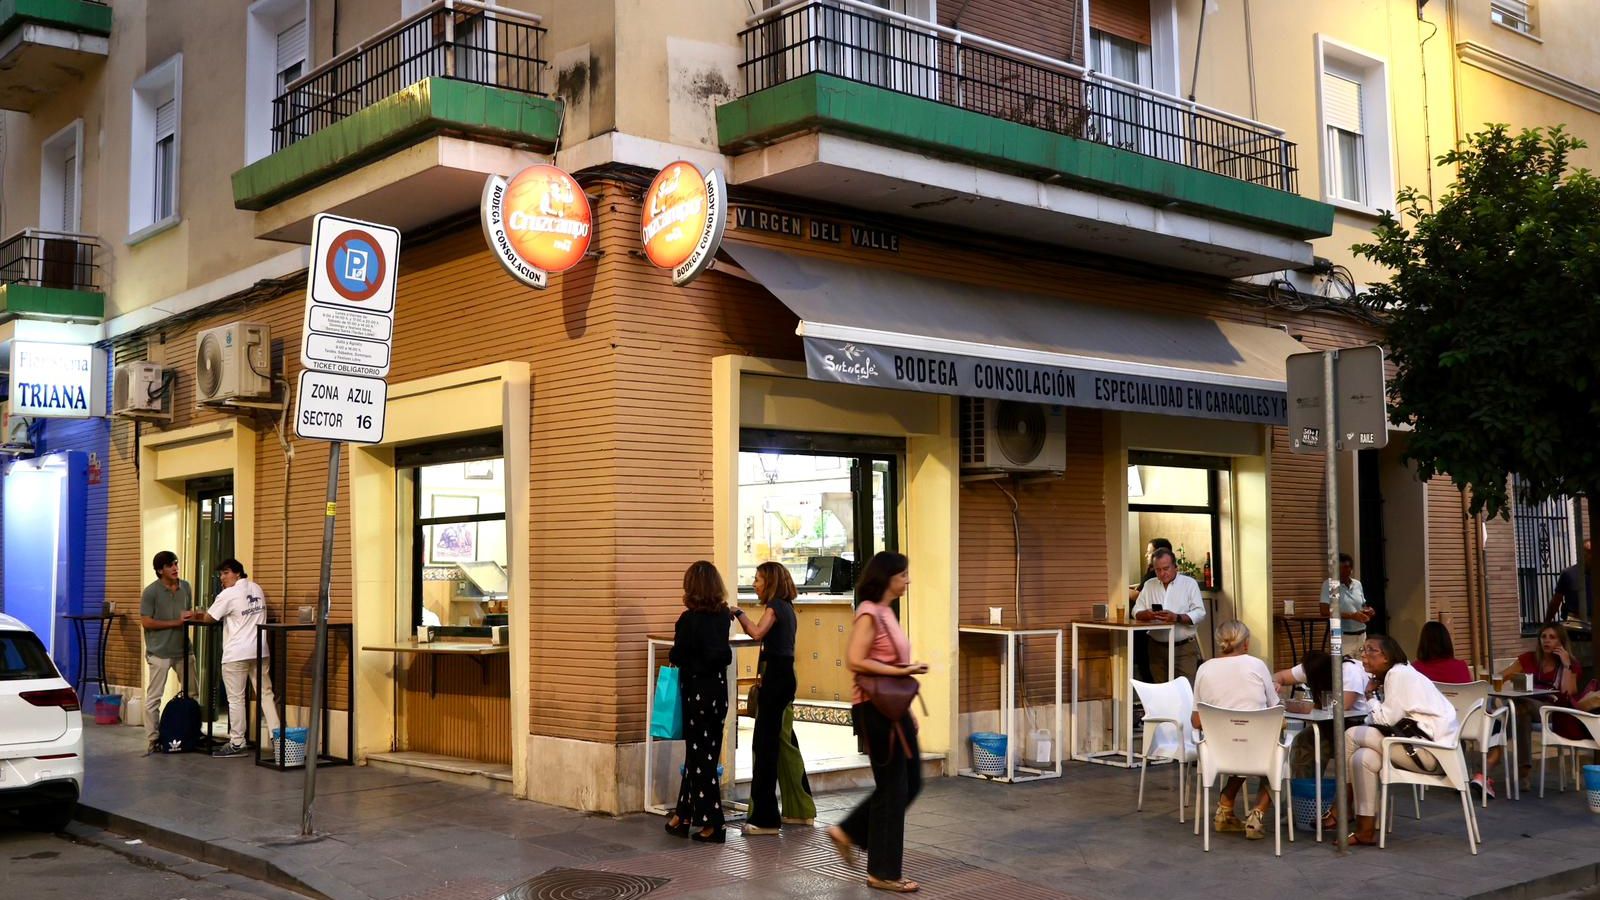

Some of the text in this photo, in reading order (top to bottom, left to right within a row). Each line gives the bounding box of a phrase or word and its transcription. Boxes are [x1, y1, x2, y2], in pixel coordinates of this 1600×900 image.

[491, 184, 541, 282] BODEGA CONSOLACION
[509, 211, 590, 239] Cruzcampo
[676, 180, 715, 278] BODEGA CONSOLACION
[736, 207, 898, 251] VIRGEN DEL VALLE
[313, 361, 380, 375] TICKET OBLIGATORIO
[18, 382, 87, 409] TRIANA
[311, 383, 374, 405] ZONA AZUL
[894, 355, 958, 386] BODEGA
[974, 364, 1075, 398] CONSOLACIÓN
[1095, 377, 1183, 409] ESPECIALIDAD
[1187, 388, 1202, 410] EN
[1205, 390, 1270, 417] CARACOLES
[1271, 396, 1278, 417] Y
[302, 410, 372, 430] SECTOR 16
